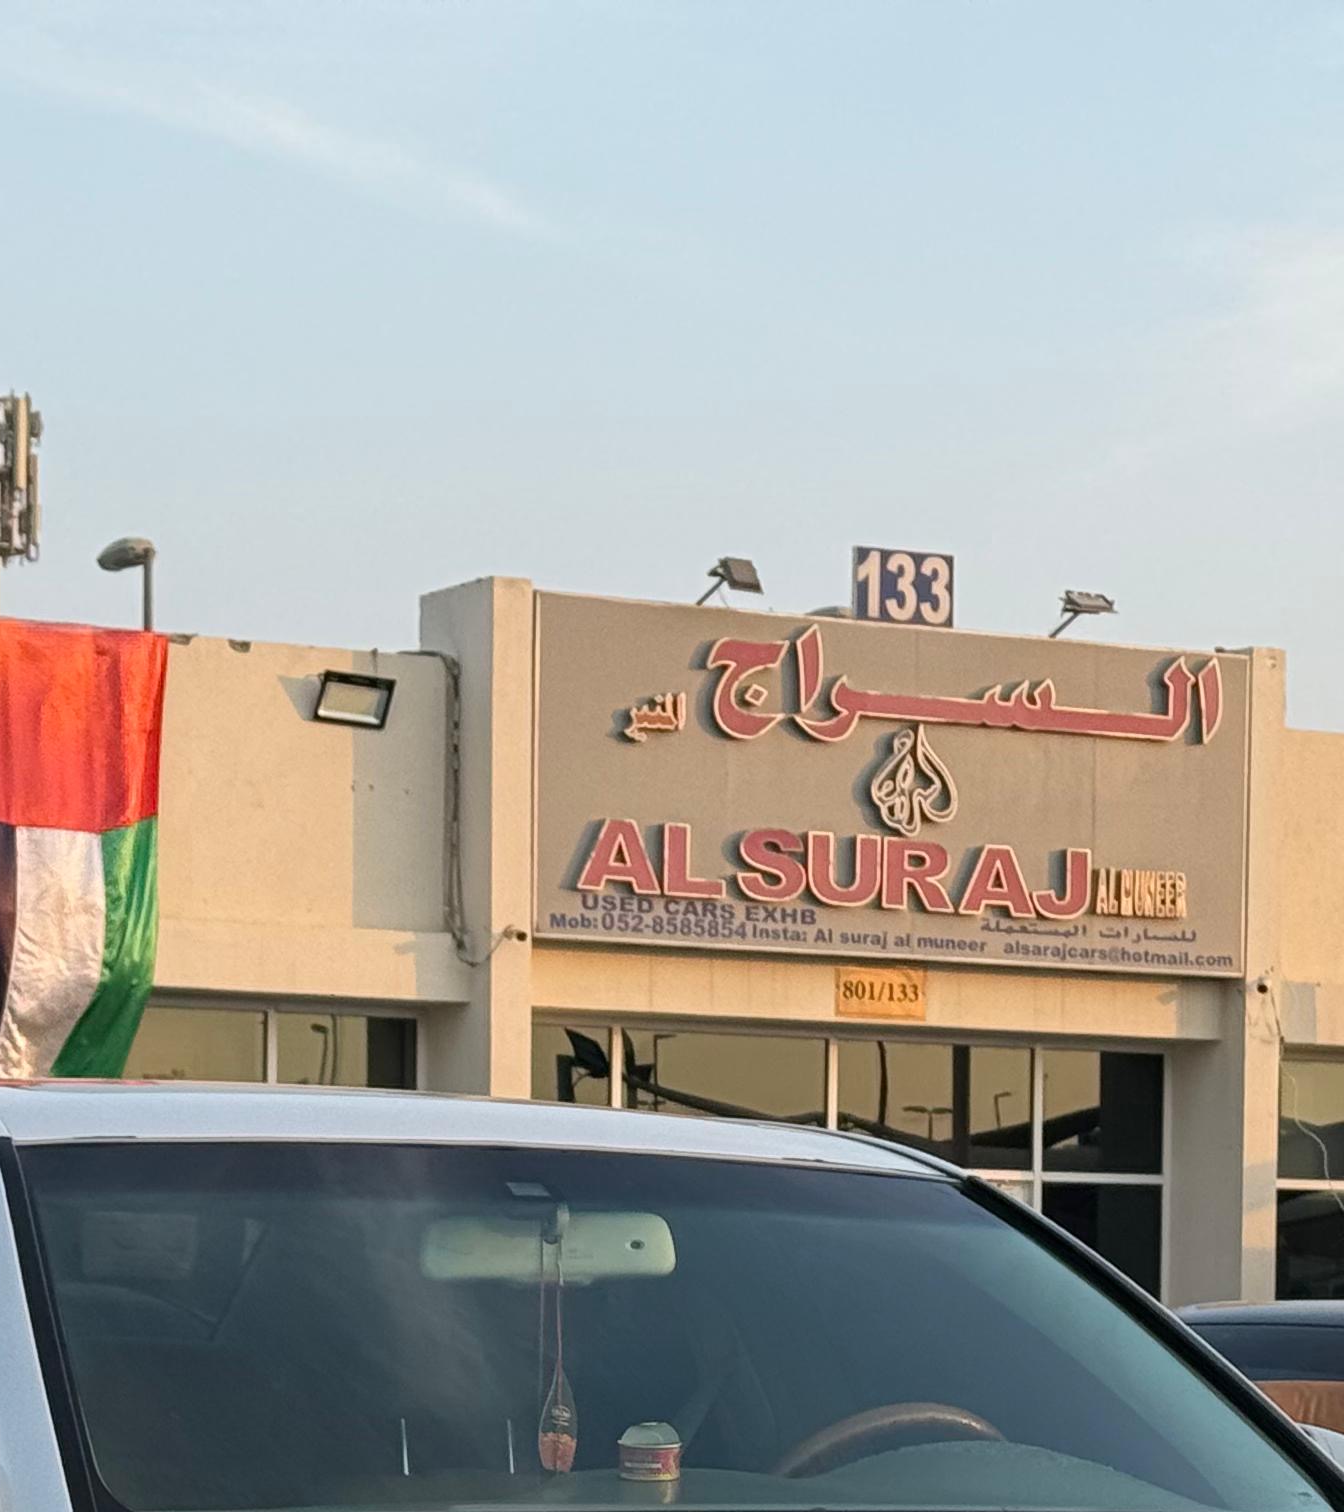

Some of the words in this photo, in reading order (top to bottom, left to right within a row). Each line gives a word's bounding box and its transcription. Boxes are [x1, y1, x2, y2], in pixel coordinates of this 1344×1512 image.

[856, 549, 951, 625] 133
[706, 623, 1223, 745] السراج
[577, 818, 726, 898] AL
[736, 828, 1093, 920] SURAJ
[580, 893, 655, 914] USED
[663, 898, 736, 920] CARS
[745, 904, 817, 925] EXHB
[752, 924, 808, 942] Insta:
[814, 927, 833, 944] Al
[839, 931, 888, 950] suraj
[894, 933, 911, 948] al
[917, 936, 987, 953] muneer
[842, 979, 920, 1003] 801/133
